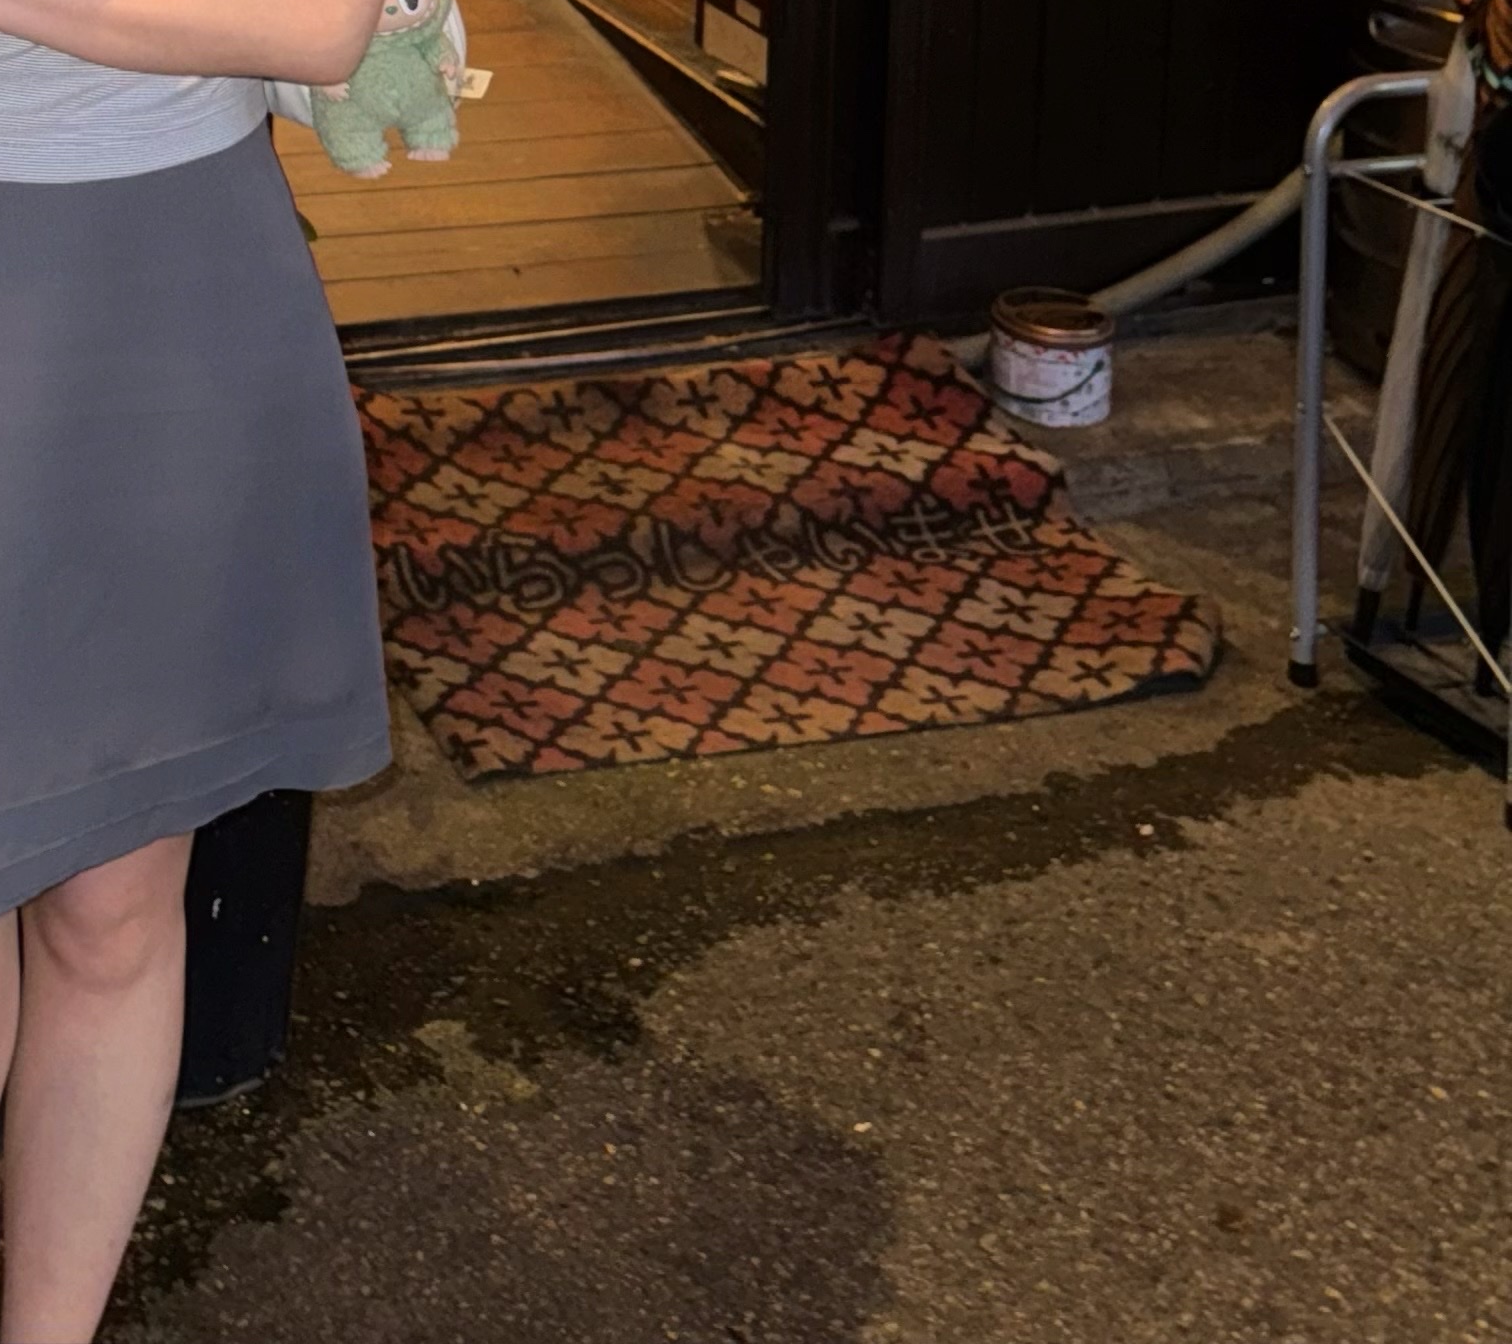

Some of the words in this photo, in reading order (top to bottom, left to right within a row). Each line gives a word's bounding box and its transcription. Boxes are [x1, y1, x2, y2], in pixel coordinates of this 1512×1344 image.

[391, 496, 1039, 613] いらっしゃいませ
